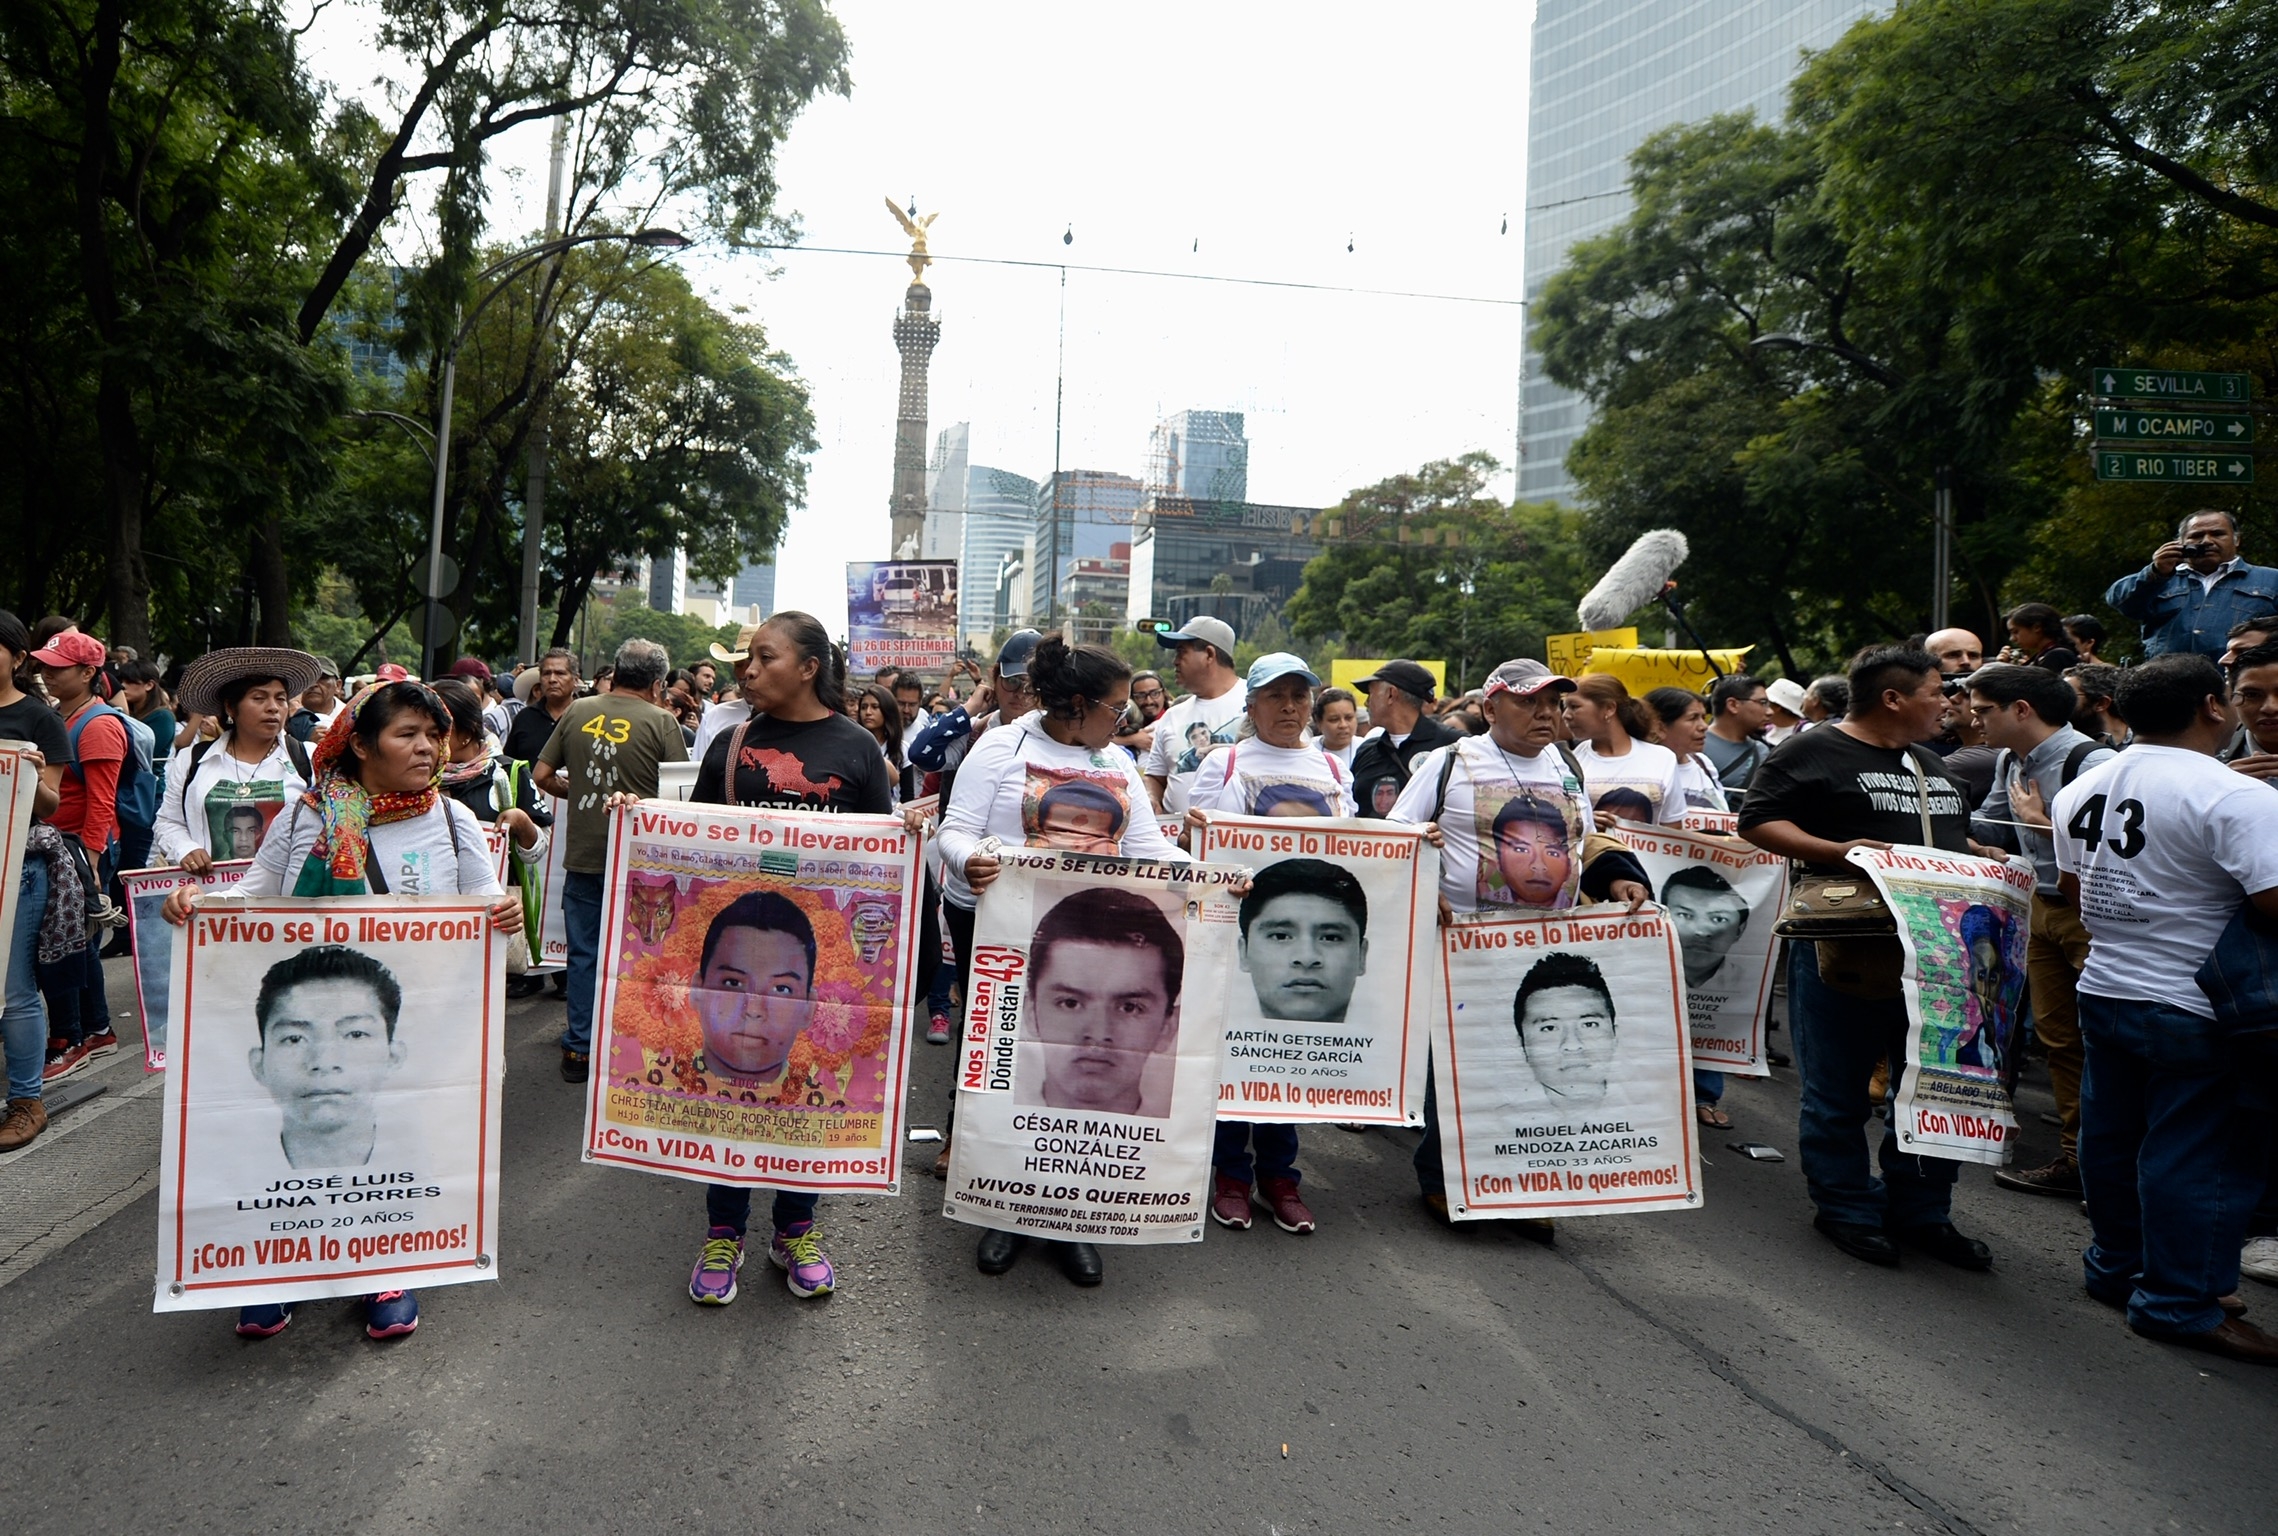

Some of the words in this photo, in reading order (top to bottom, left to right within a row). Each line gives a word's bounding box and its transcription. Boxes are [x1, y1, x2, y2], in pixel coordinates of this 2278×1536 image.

[2134, 375, 2206, 394] SEVILLA
[2226, 382, 2235, 393] 3
[2113, 417, 2127, 434] M
[2138, 418, 2215, 436] OCAMPO
[2111, 460, 2120, 472] 2
[2136, 459, 2164, 475] RIO
[2172, 460, 2217, 476] TIBER
[1241, 506, 1311, 530] HSBC
[864, 640, 877, 651] 26
[880, 641, 891, 651] DE
[893, 640, 954, 652] SEPTIEMBRE
[865, 655, 878, 666] NO
[881, 656, 892, 666] SE
[894, 655, 928, 667] OLVIDA
[581, 713, 631, 744] 43
[1869, 792, 1899, 812] VIVOS
[1897, 793, 1915, 814] LOS
[632, 811, 698, 838] ¡Vivo
[707, 823, 739, 843] se
[750, 823, 774, 845] lo
[783, 826, 906, 855] llevaron!
[2068, 794, 2146, 860] 43
[1209, 828, 1264, 852] ¡Vivo
[1270, 834, 1293, 853] se
[1300, 834, 1318, 855] lo
[1325, 836, 1413, 860] llevaron!
[1662, 843, 1682, 857] se
[1688, 843, 1705, 862] lo
[820, 866, 845, 875] saber
[877, 870, 898, 879] está
[1061, 859, 1085, 873] SE
[1092, 861, 1129, 876] LOS
[1869, 849, 1926, 871] ¡Vivo
[1927, 859, 1951, 873] se
[1949, 861, 1975, 877] lo
[1973, 862, 2035, 892] llevaron!
[134, 877, 173, 895] ¡Vivo
[178, 876, 196, 887] se
[198, 917, 275, 947] ¡Vivo
[283, 921, 314, 944] se
[324, 917, 350, 942] lo
[359, 916, 481, 943] llevaron!
[1451, 930, 1507, 953] ¡Vivo
[1513, 927, 1536, 947] se
[1542, 921, 1562, 945] lo
[1568, 918, 1663, 943] llevaron!
[967, 981, 992, 1042] faltan
[998, 985, 1021, 1032] están
[1687, 1002, 1720, 1012] GUEZ
[1225, 1030, 1278, 1045] MARTÍN
[1283, 1033, 1374, 1048] GETSEMANY
[990, 1037, 1014, 1091] Dónde
[1230, 1045, 1303, 1061] SÁNCHEZ
[1307, 1048, 1363, 1064] GARCÍA
[964, 1050, 984, 1088] Nos
[1249, 1064, 1286, 1075] EDAD
[1290, 1066, 1307, 1075] 20
[1311, 1066, 1348, 1078] AÑOS
[1241, 1081, 1282, 1103] VIDA
[1287, 1083, 1300, 1103] lo
[1306, 1087, 1393, 1108] queremos!
[1930, 1081, 1980, 1098] ABELARDO
[610, 1093, 676, 1114] CHRISTIAN
[681, 1104, 735, 1122] ALFONSO
[740, 1112, 810, 1130] RODRÍGUEZ
[818, 1118, 877, 1130] TELUMBRE
[617, 1109, 640, 1121] Hijo
[643, 1111, 655, 1123] de
[659, 1114, 705, 1130] Clemente
[710, 1124, 716, 1132] y
[721, 1123, 737, 1134] Luz
[742, 1125, 776, 1139] María,
[783, 1131, 822, 1144] Tixtla,
[828, 1133, 840, 1142] 19
[848, 1132, 868, 1142] años
[1012, 1113, 1078, 1134] CÉSAR
[1084, 1120, 1166, 1143] MANUEL
[1515, 1125, 1577, 1139] MIGUEL
[1580, 1120, 1635, 1135] ÁNGEL
[1917, 1109, 1949, 1135] ¡Con
[1950, 1113, 1987, 1140] VIDA
[1987, 1118, 2004, 1142] lo
[598, 1128, 648, 1153] ¡Con
[656, 1137, 716, 1164] VIDA
[724, 1147, 745, 1168] lo
[754, 1154, 887, 1175] queremos!
[1034, 1137, 1141, 1161] GONZÁLEZ
[1495, 1139, 1576, 1156] MENDOZA
[1578, 1136, 1658, 1152] ZACARIAS
[1024, 1156, 1146, 1181] HERNÁNDEZ
[1527, 1158, 1568, 1168] EDAD
[1572, 1156, 1588, 1166] 33
[1593, 1153, 1632, 1166] AÑOS
[265, 1174, 343, 1193] JOSÉ
[352, 1171, 415, 1186] LUIS
[968, 1177, 1037, 1197] ¡VIVOS
[1041, 1185, 1079, 1201] LOS
[1085, 1188, 1191, 1206] QUEREMOS
[1474, 1171, 1512, 1198] ¡Con
[1519, 1168, 1561, 1193] VIDA
[1567, 1167, 1583, 1191] lo
[1588, 1164, 1678, 1194] queremos!
[236, 1194, 316, 1212] LUNA
[325, 1184, 441, 1204] TORRES
[955, 1191, 992, 1208] CONTRA
[994, 1200, 1006, 1210] EL
[1009, 1202, 1068, 1218] TERRORISMO
[1070, 1209, 1088, 1220] DEL
[1090, 1211, 1128, 1224] ESTADO,
[1130, 1213, 1141, 1223] LA
[1144, 1211, 1198, 1224] SOLIDARIDAD
[270, 1217, 324, 1232] EDAD
[331, 1215, 354, 1228] 20
[360, 1210, 414, 1226] AÑOS
[1015, 1216, 1073, 1233] AYOTZINAPA
[1075, 1224, 1107, 1235] SOMXS
[1110, 1225, 1139, 1236] TODXS
[192, 1243, 245, 1274] ¡Con
[253, 1237, 312, 1265] VIDA
[319, 1235, 340, 1261] lo
[347, 1223, 467, 1263] queremos!
